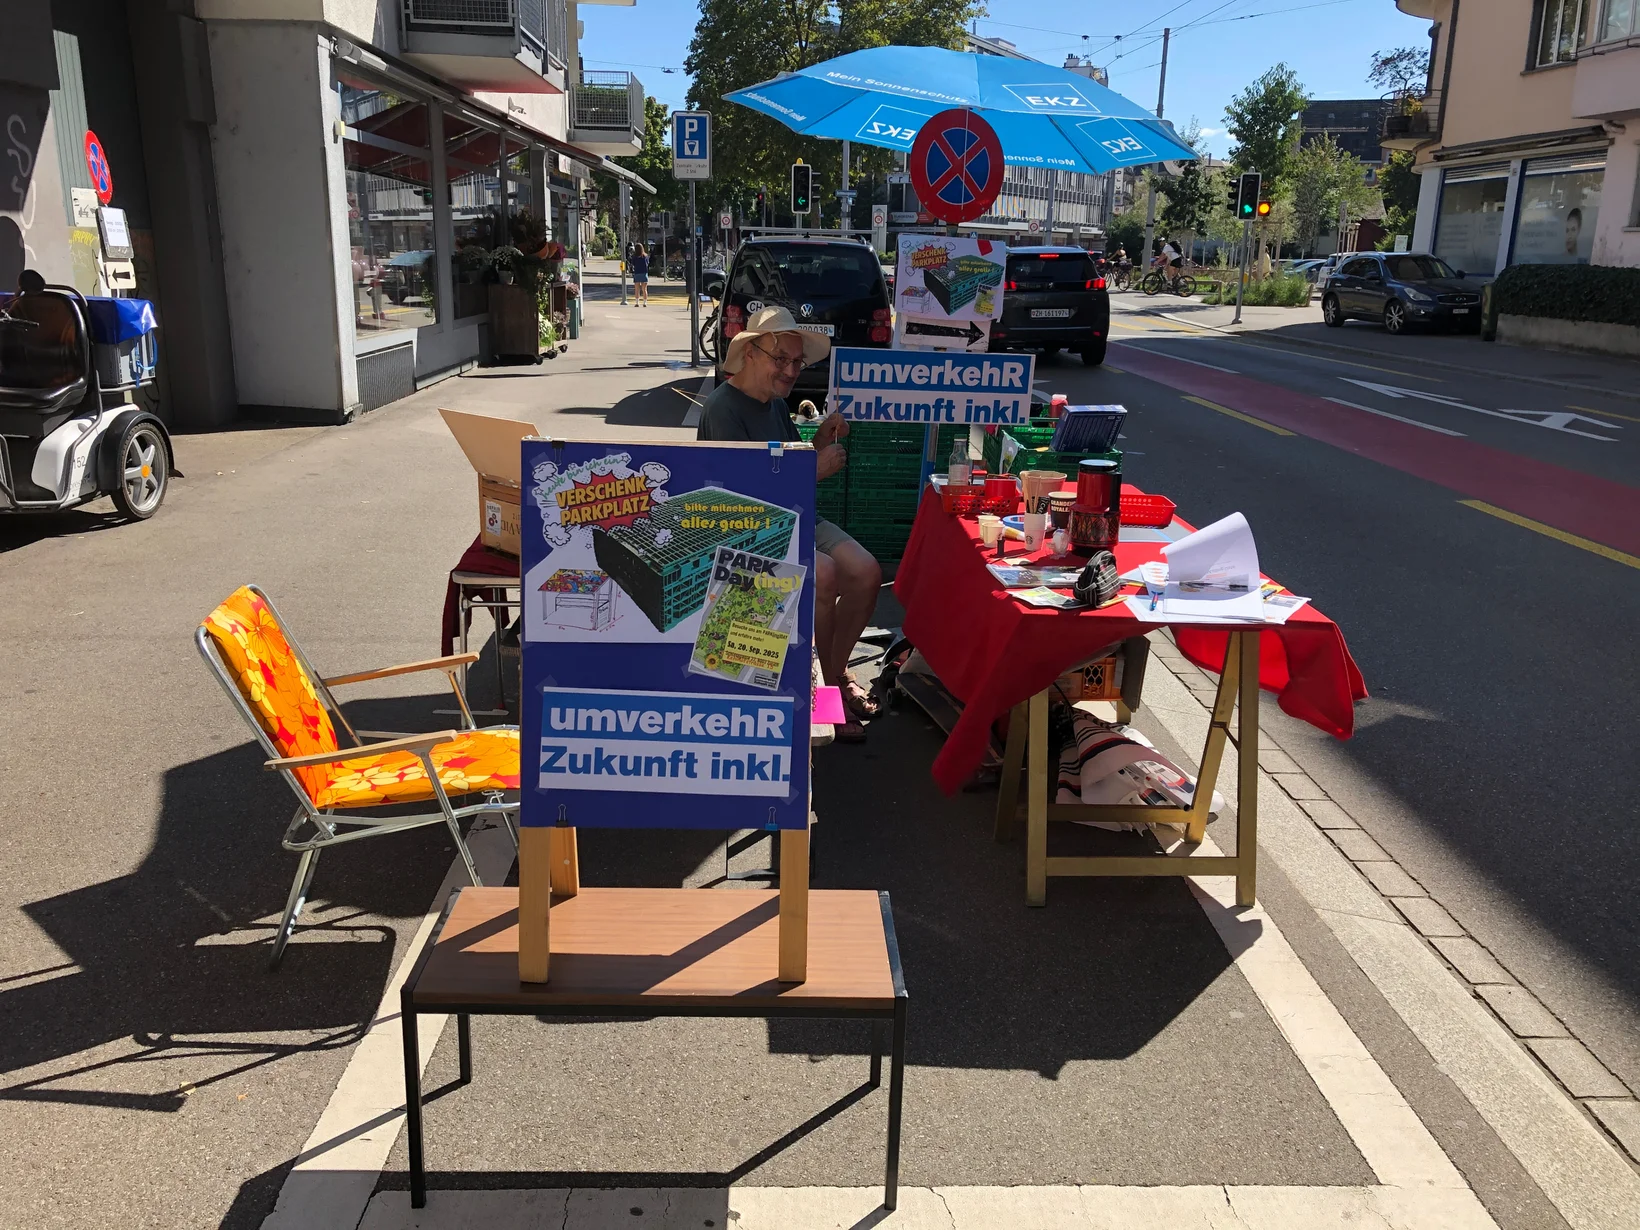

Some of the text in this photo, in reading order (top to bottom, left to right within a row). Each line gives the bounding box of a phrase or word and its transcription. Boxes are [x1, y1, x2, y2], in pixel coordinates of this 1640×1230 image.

[826, 71, 861, 82] Mein
[1025, 96, 1087, 107] EKZ
[685, 118, 698, 139] P
[911, 247, 947, 261] VERSCHENK
[911, 255, 947, 268] PARKPLATZ
[749, 302, 763, 312] CH
[840, 359, 1024, 388] umverkehR
[833, 395, 1026, 424] Zukunft inkl.
[566, 467, 585, 480] bin
[585, 459, 604, 472] ich
[603, 456, 622, 466] ein
[555, 475, 648, 509] VERSCHENK
[560, 494, 651, 526] PARKPLATZ
[684, 502, 766, 513] bitte mitnehmen
[680, 515, 771, 532] alles gratis !
[717, 550, 781, 578] PARK
[713, 565, 801, 593] Day(ing)
[737, 643, 748, 652] 20.
[749, 645, 762, 655] Sep.
[763, 649, 780, 659] 2025
[550, 704, 785, 739] umverkehR
[540, 744, 790, 782] Zukunft inkl.
